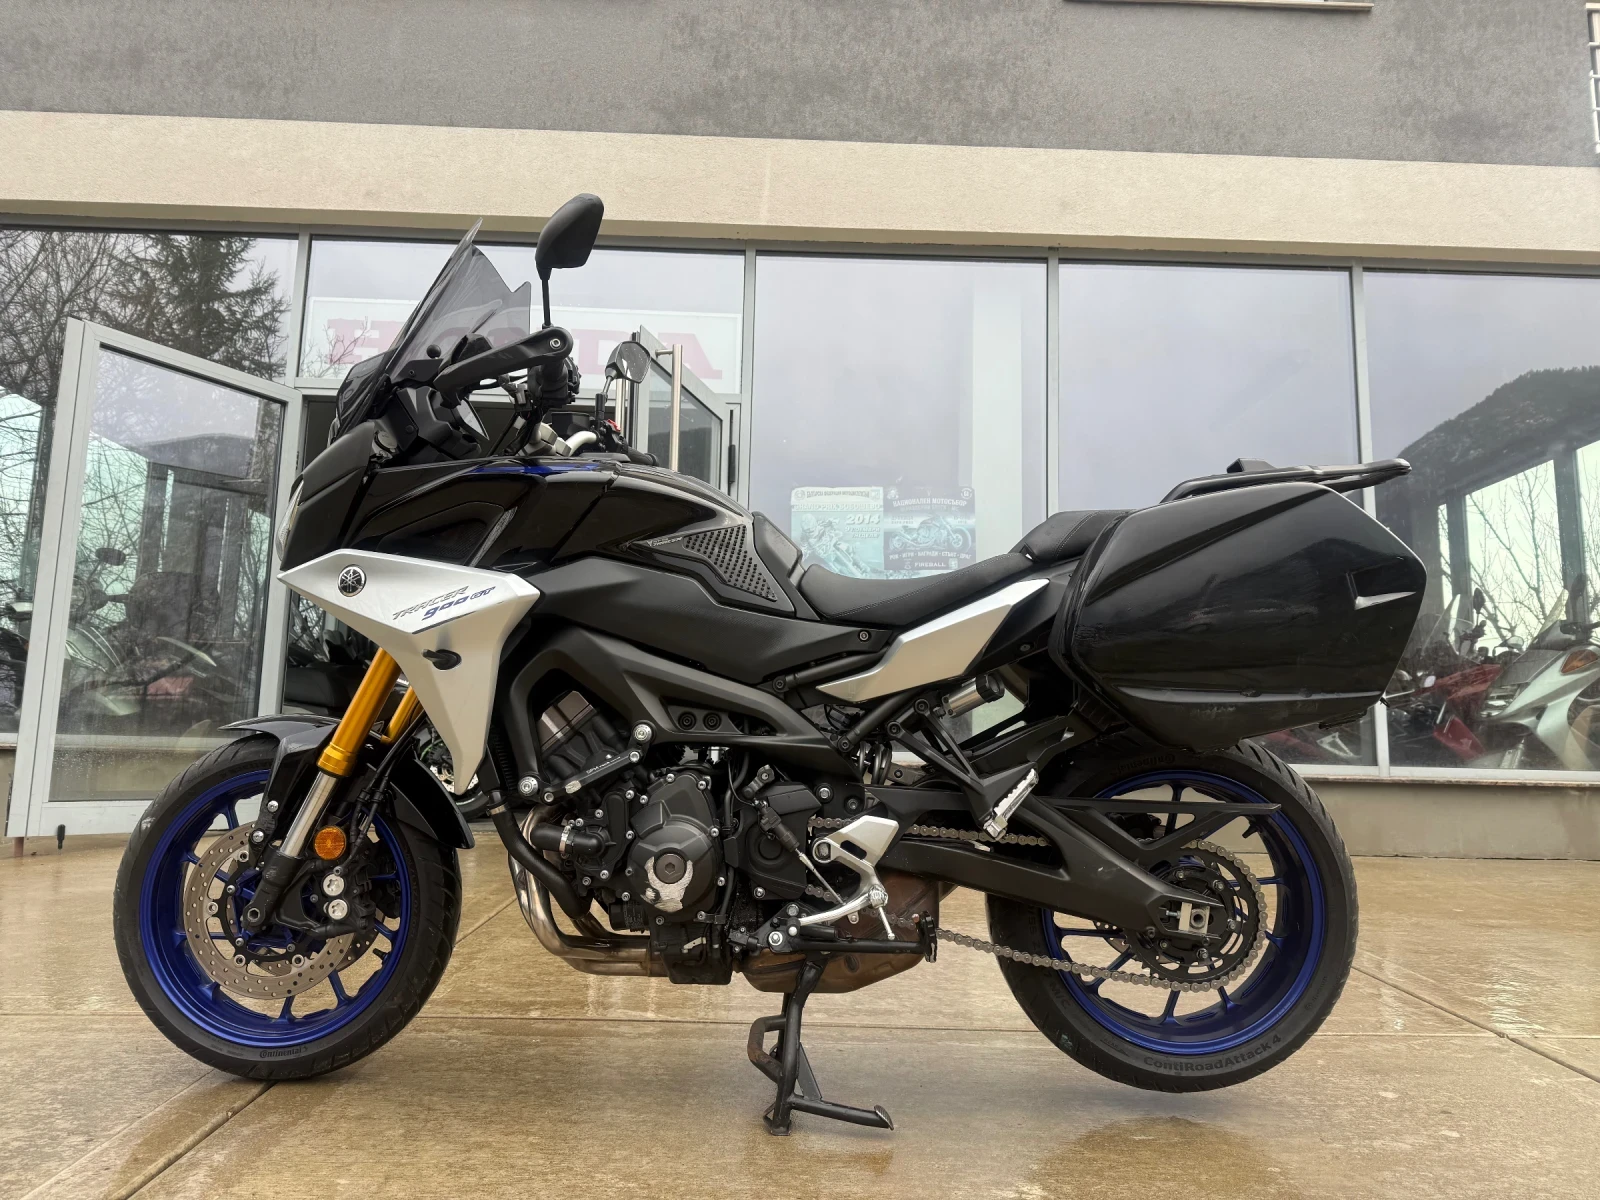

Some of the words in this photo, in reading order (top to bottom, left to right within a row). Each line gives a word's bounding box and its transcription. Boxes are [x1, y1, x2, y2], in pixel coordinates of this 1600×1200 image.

[893, 497, 930, 507] НАЦИОНАЛЕН
[932, 497, 967, 507] МОТОСЪБОР
[845, 513, 880, 526] 2014
[392, 585, 469, 620] TRACER
[259, 1046, 302, 1059] Continental
[1143, 1040, 1272, 1072] ContiRoadAttack
[1271, 1033, 1282, 1044] 4
